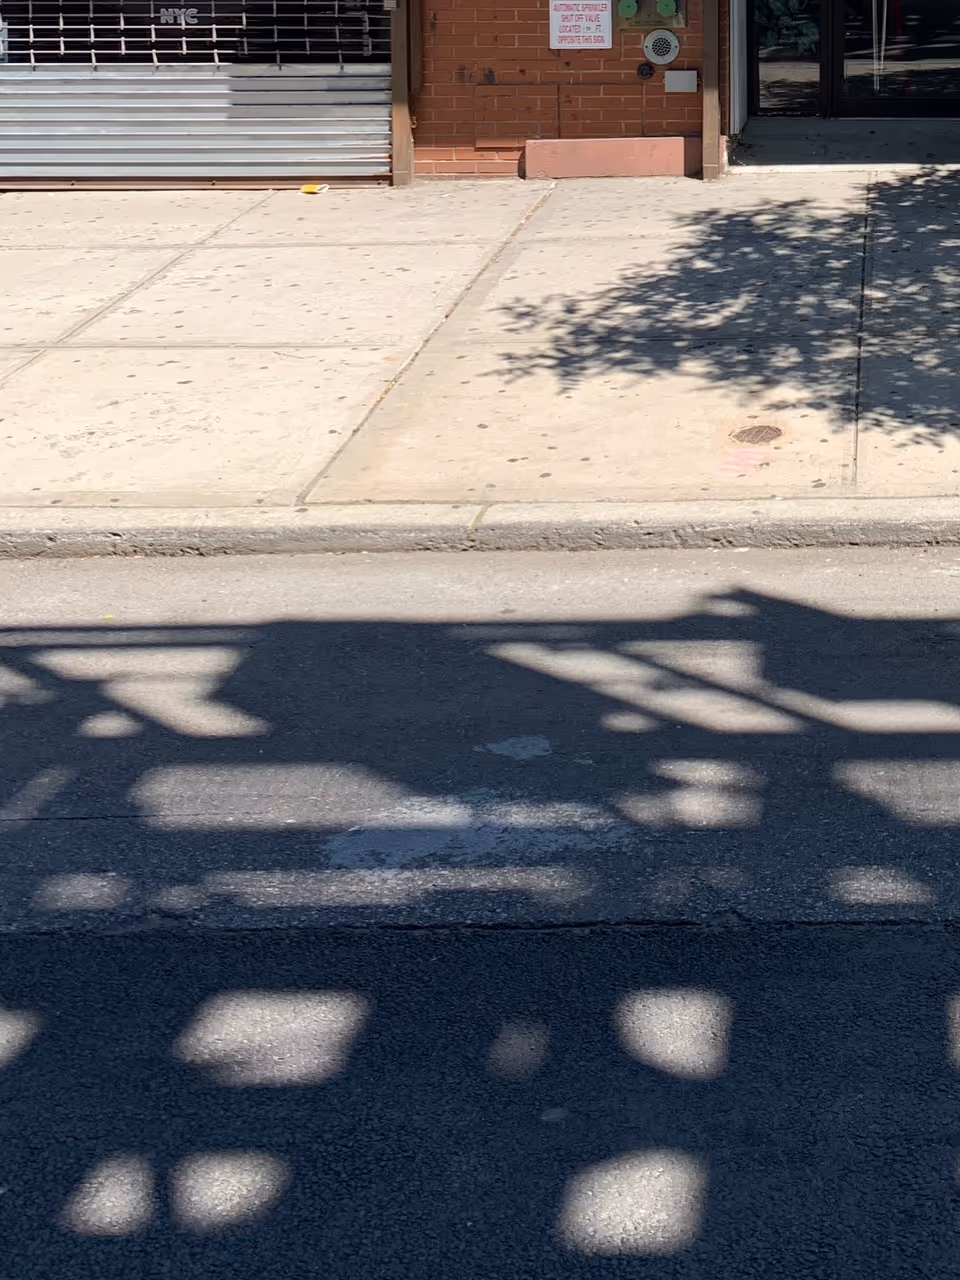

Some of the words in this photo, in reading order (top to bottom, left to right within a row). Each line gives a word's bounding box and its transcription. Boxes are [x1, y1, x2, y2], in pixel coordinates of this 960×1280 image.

[159, 7, 199, 24] NYC
[559, 24, 581, 33] LOCATED
[592, 35, 605, 44] SIGN
